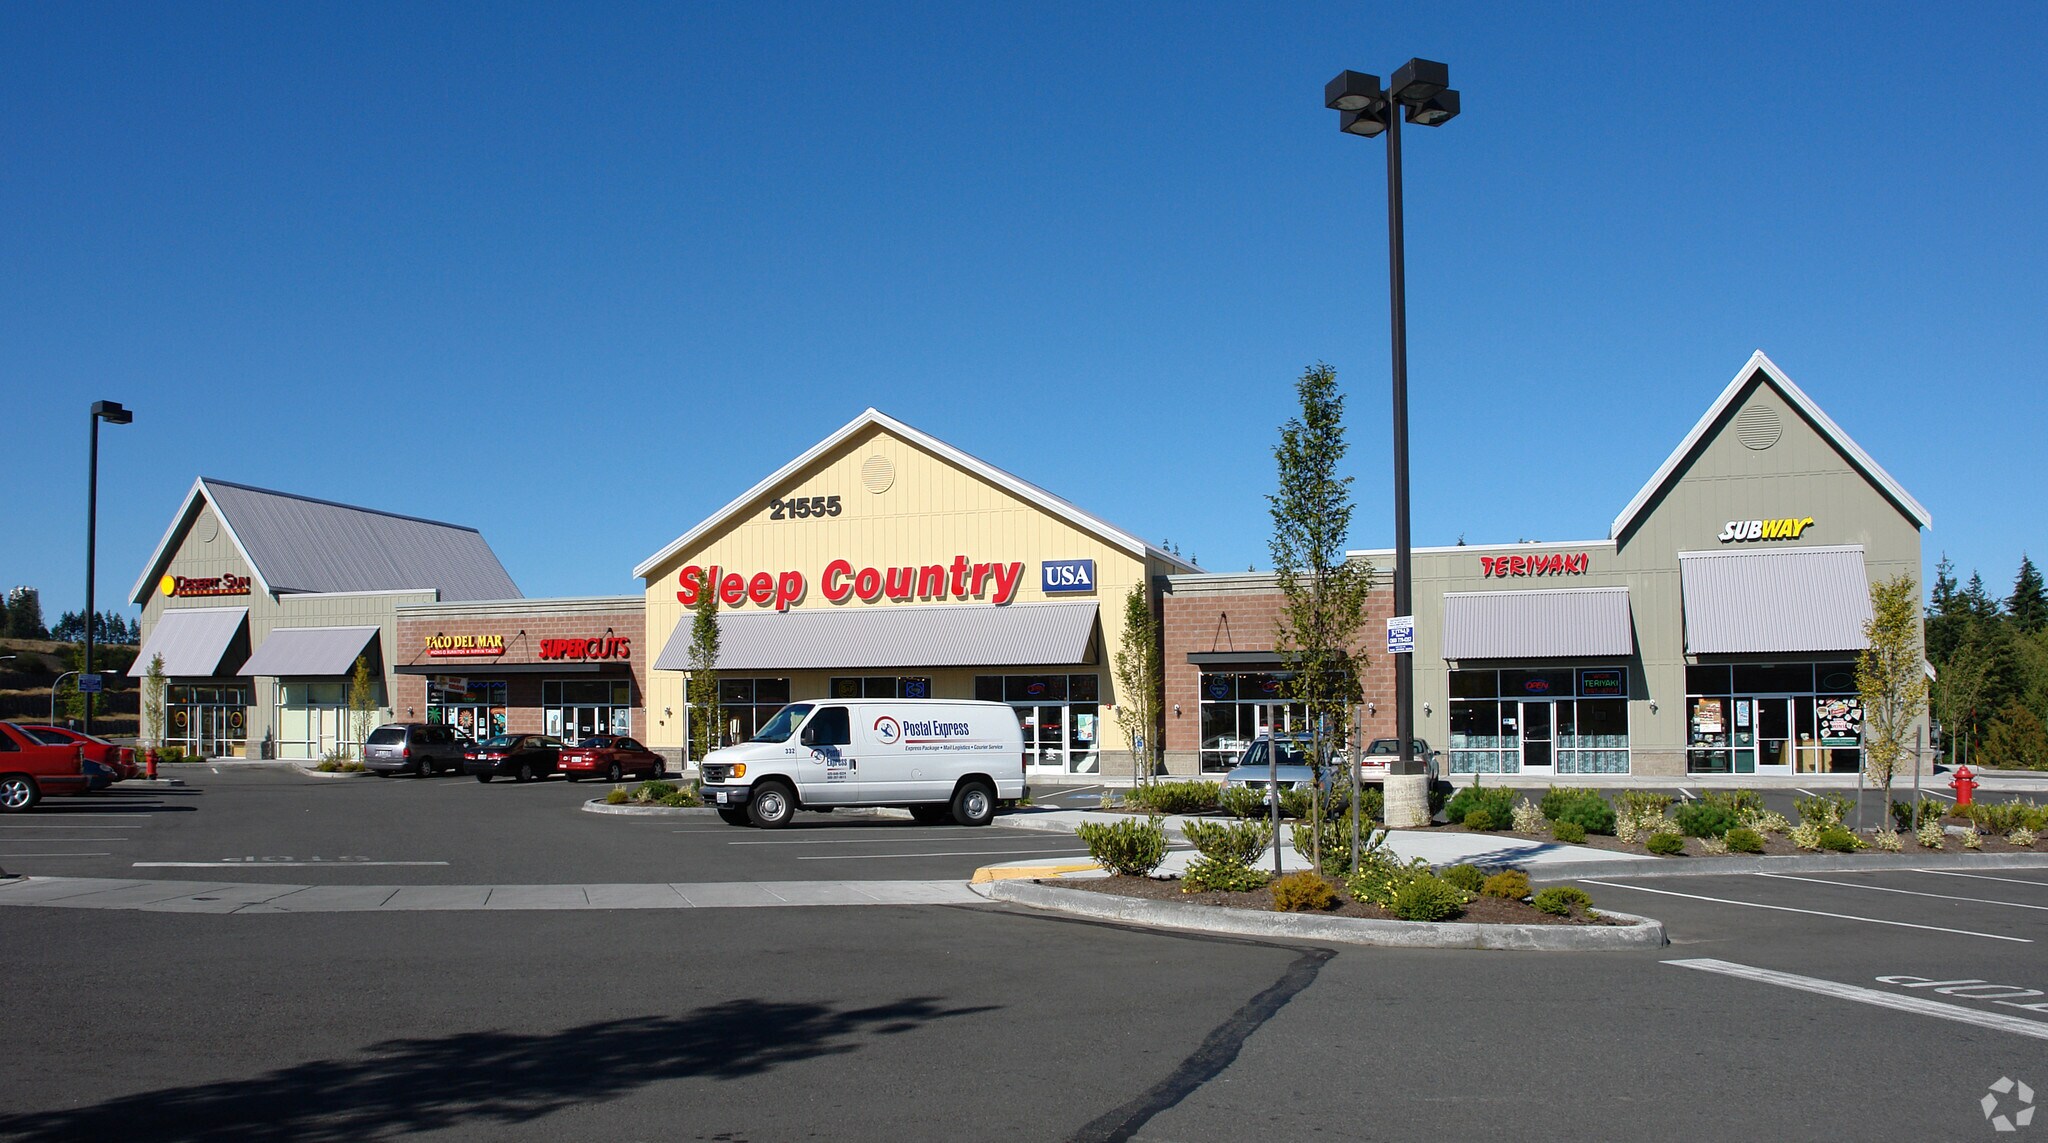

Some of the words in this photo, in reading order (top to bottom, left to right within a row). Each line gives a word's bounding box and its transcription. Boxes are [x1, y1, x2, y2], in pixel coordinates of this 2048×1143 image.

[769, 496, 843, 520] 21555
[1717, 517, 1814, 542] SUBWAY
[1480, 553, 1588, 578] TERIYAKI
[223, 573, 251, 589] SUN
[676, 565, 806, 611] Sleep
[821, 555, 1024, 605] Country
[1045, 566, 1091, 587] USA
[176, 588, 213, 596] TANNING
[219, 587, 247, 595] SALON
[425, 635, 453, 649] TACO
[453, 635, 475, 648] DEL
[477, 634, 504, 648] MAR
[538, 637, 631, 659] SUPERCUTS
[1525, 681, 1549, 690] OPEN
[1584, 679, 1619, 688] TERIYAKI
[903, 720, 933, 737] Postal
[934, 720, 970, 738] Express
[826, 749, 842, 758] Postal
[826, 759, 848, 767] Express
